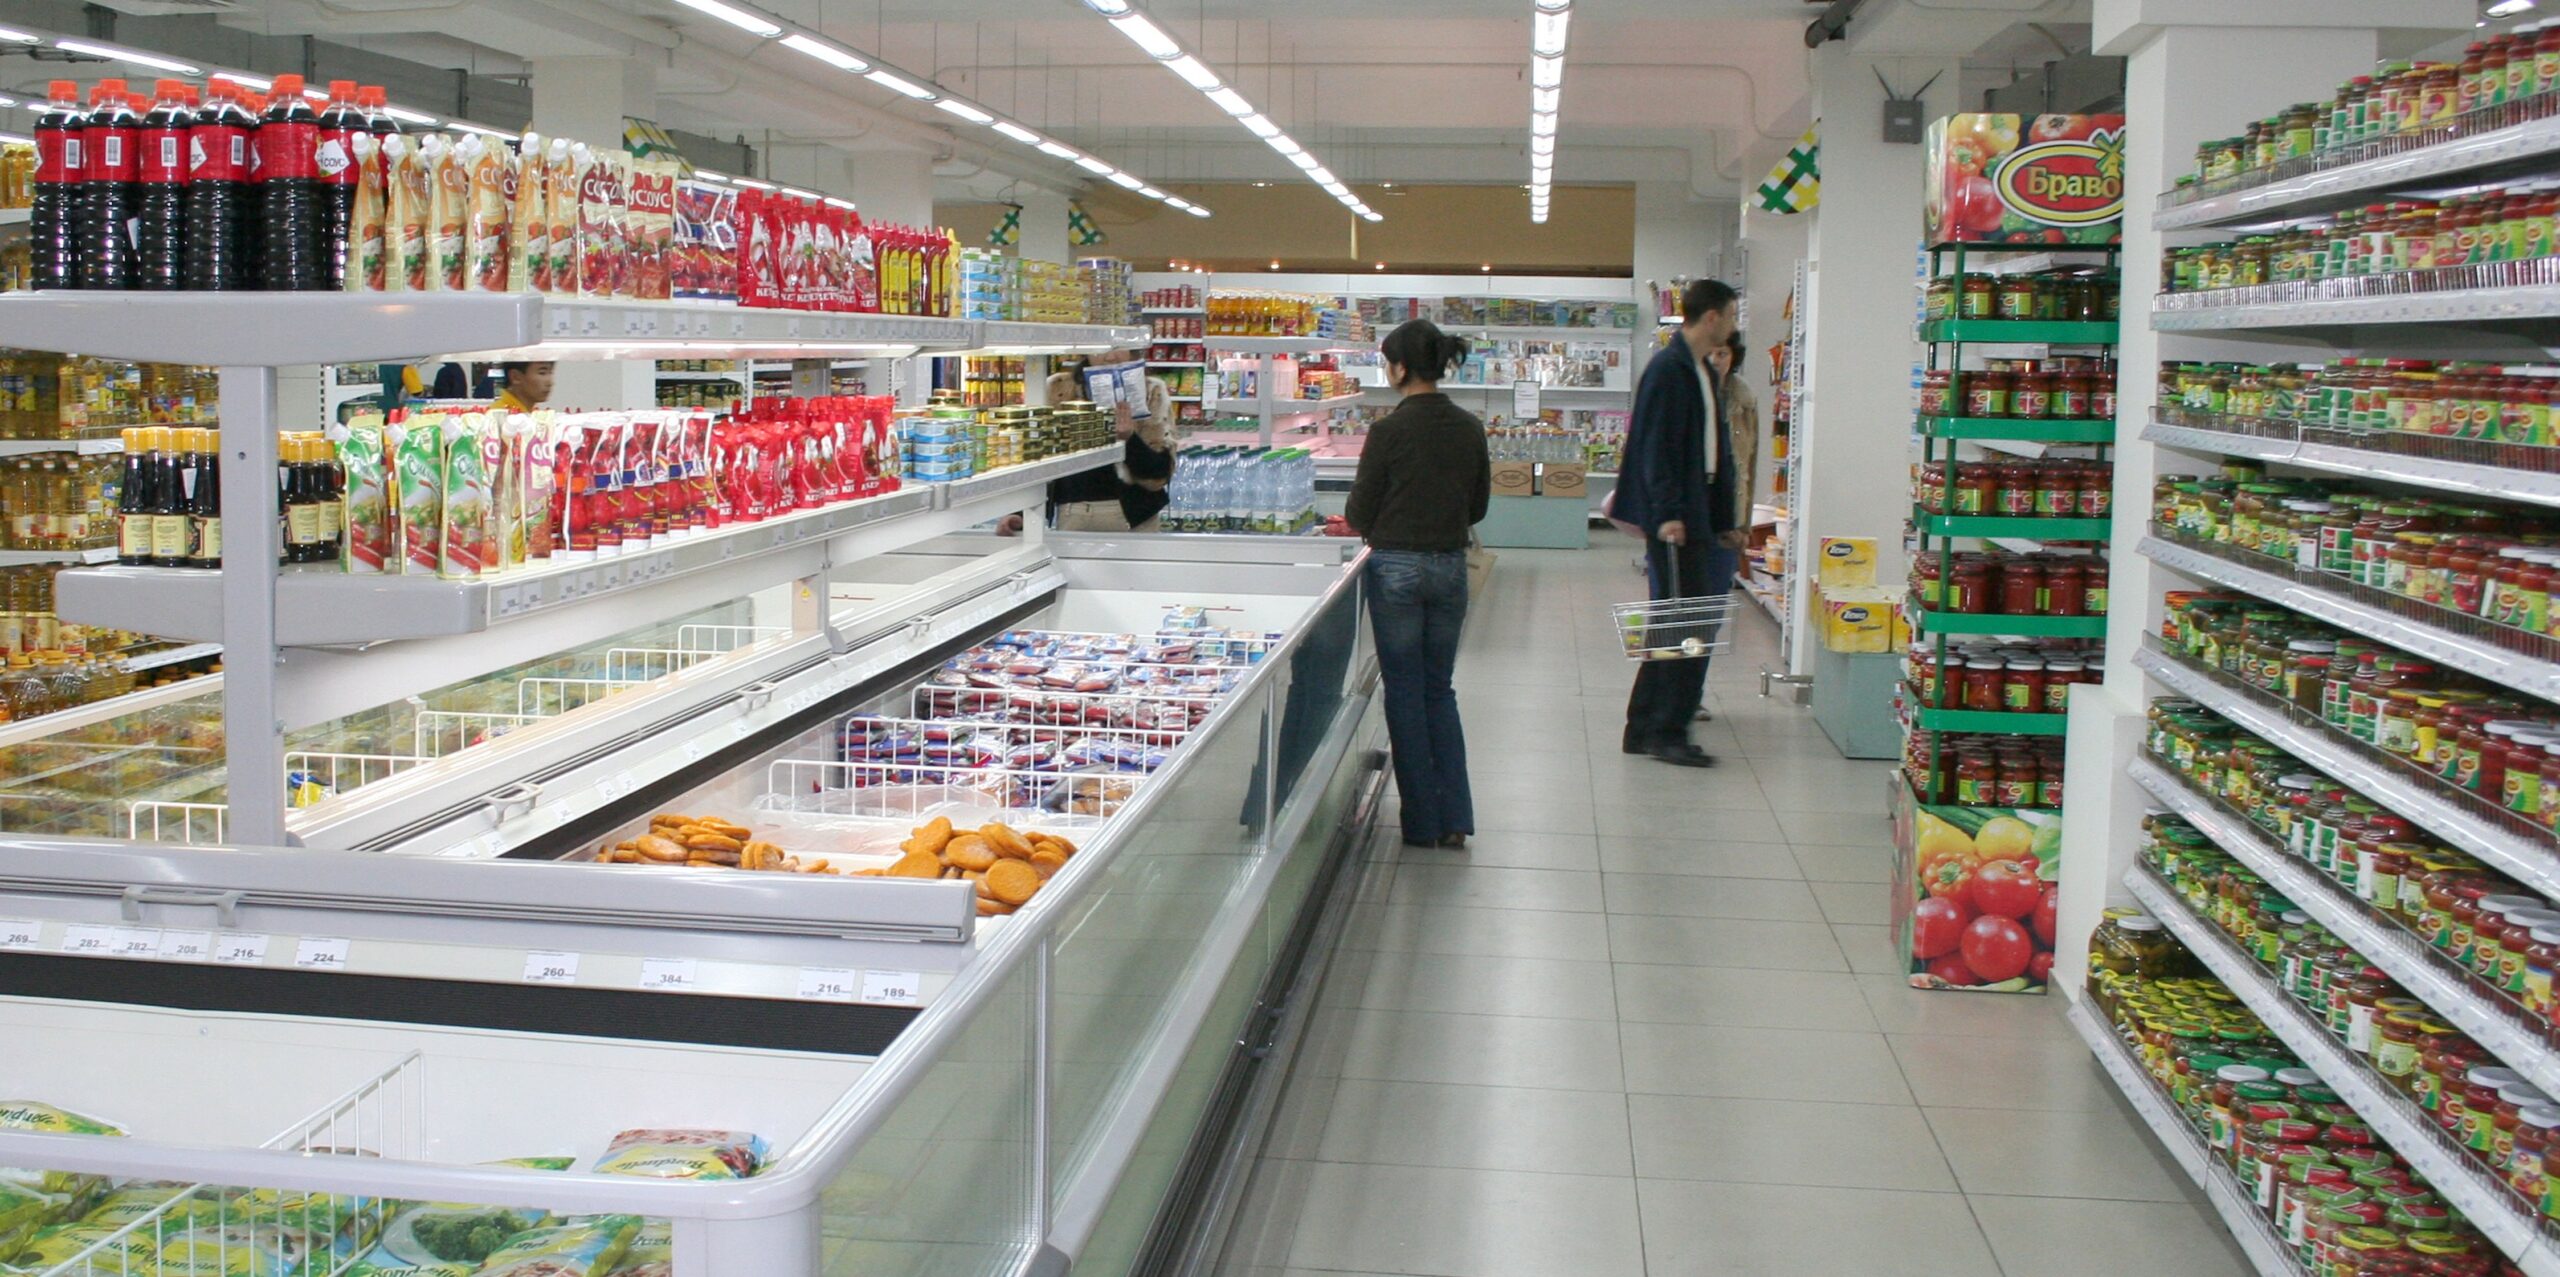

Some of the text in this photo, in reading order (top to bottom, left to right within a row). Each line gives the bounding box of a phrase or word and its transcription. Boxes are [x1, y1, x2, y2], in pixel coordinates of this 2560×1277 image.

[2027, 166, 2121, 202] Браво
[8, 933, 29, 943] 269
[79, 938, 100, 948] 282
[127, 941, 148, 951] 282
[233, 948, 254, 958] 216
[313, 952, 334, 962] 224
[542, 967, 565, 977] 260
[659, 973, 682, 984] 384
[817, 983, 840, 993] 216
[882, 987, 905, 998] 189
